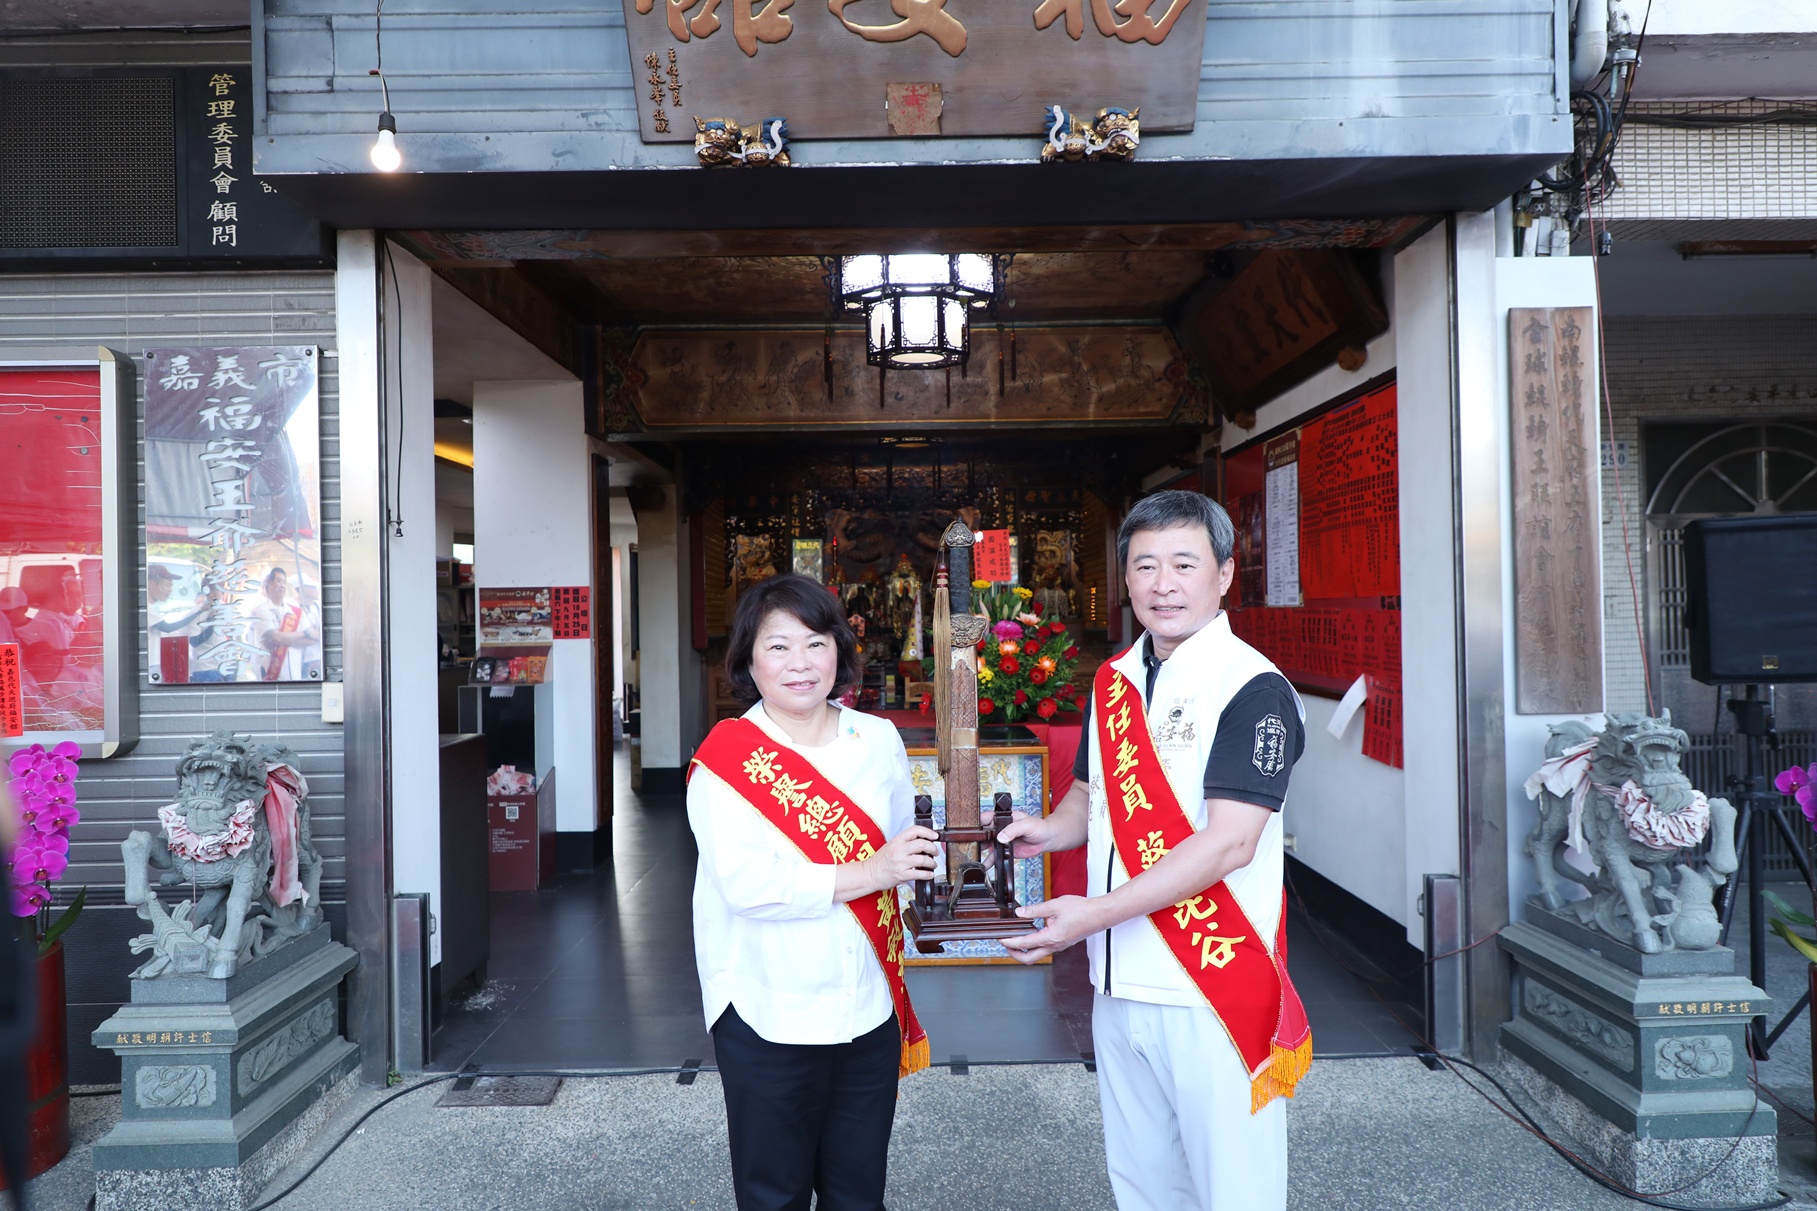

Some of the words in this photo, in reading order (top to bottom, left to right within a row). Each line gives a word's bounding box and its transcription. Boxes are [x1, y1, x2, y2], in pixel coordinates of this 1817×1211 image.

[206, 73, 239, 248] 管理委員會顧問
[159, 352, 304, 391] 嘉義市
[197, 395, 271, 678] 福安王爺慈善會
[5, 649, 15, 667] 恭祝
[1105, 670, 1153, 822] 主任委員
